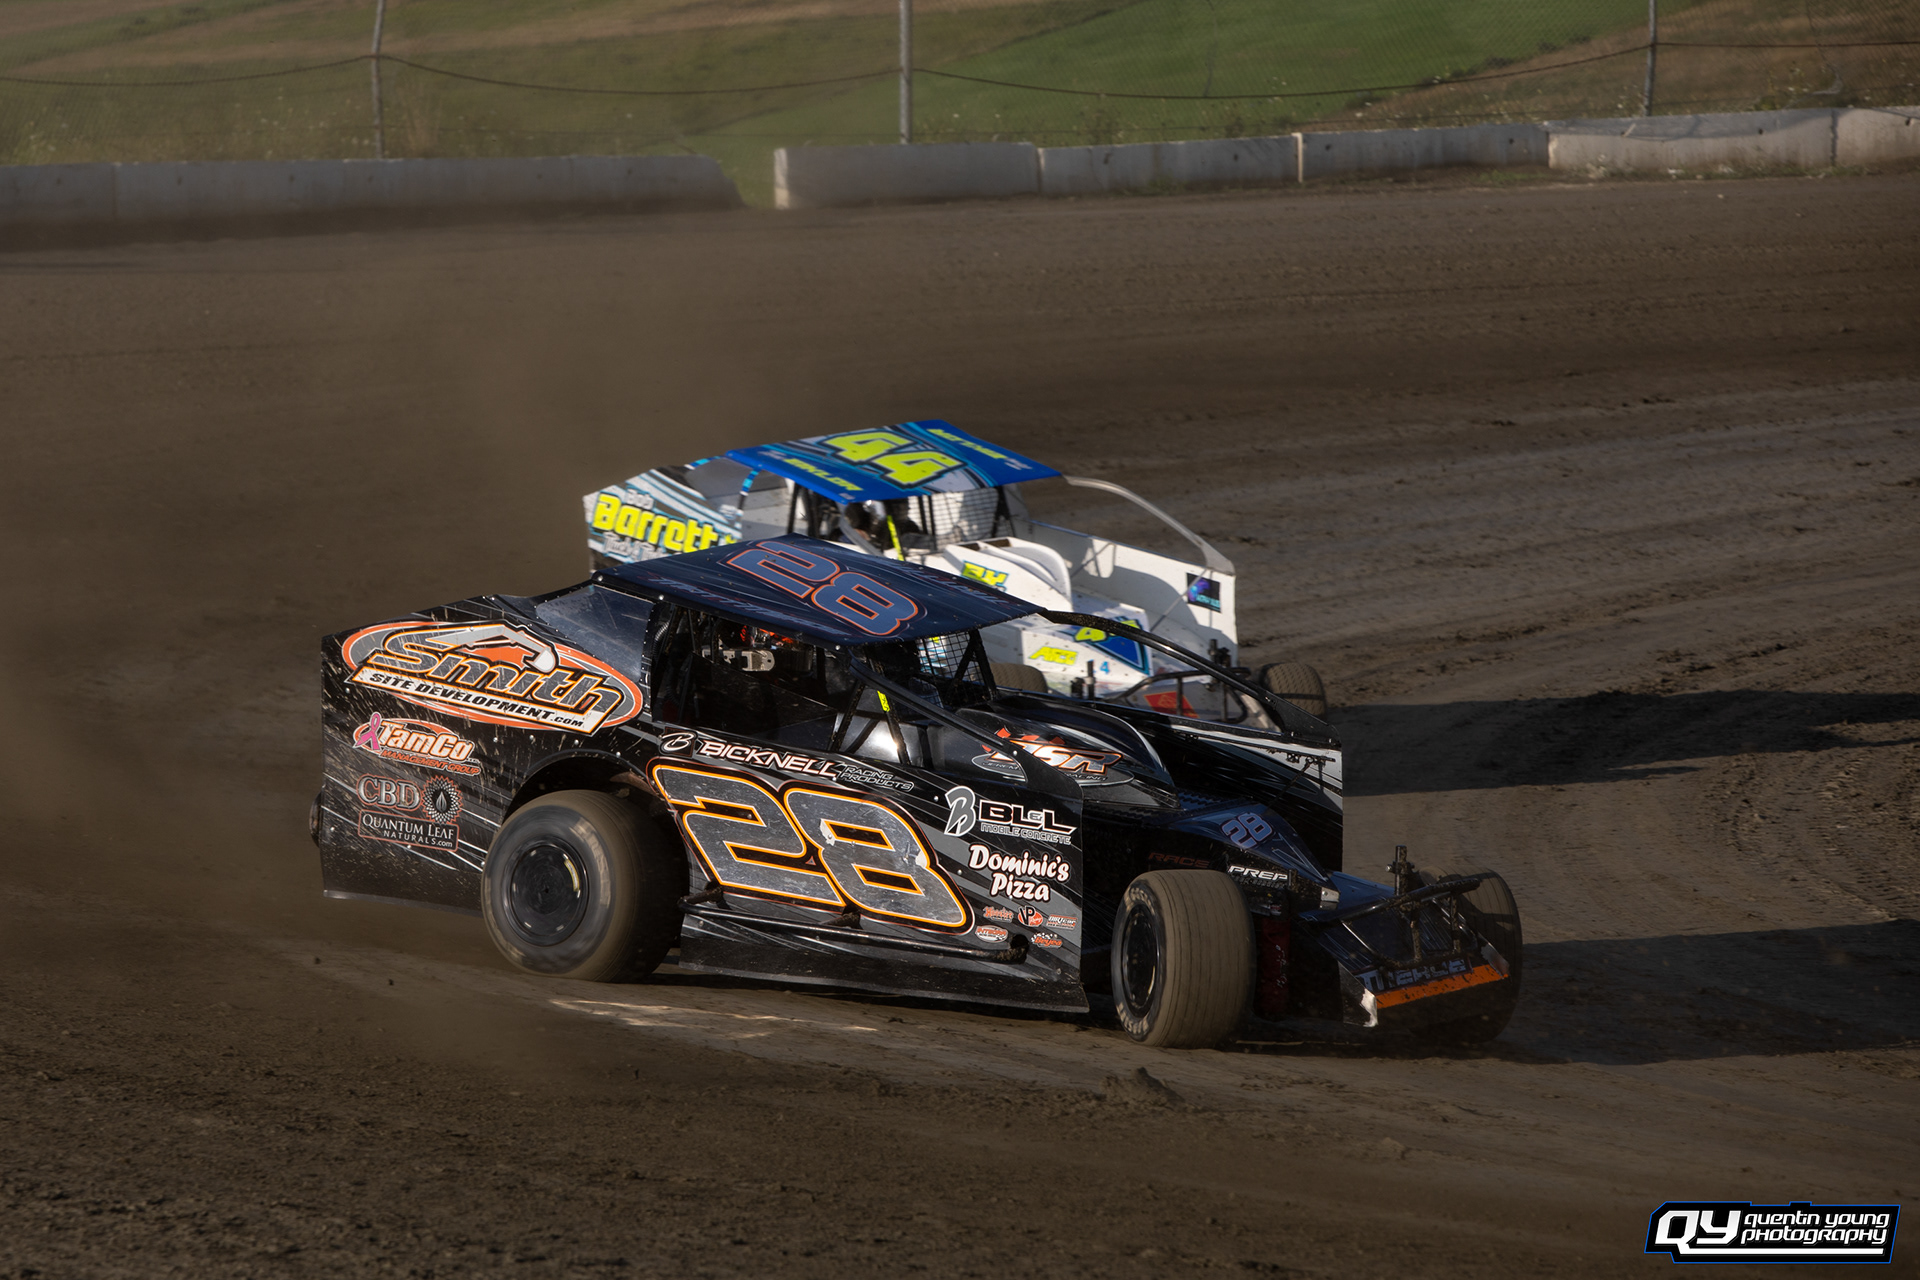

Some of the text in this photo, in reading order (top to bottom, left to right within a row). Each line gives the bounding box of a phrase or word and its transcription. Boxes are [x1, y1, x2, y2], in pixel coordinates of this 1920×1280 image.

[823, 431, 966, 487] 44
[592, 494, 719, 553] Barrett
[725, 540, 919, 636] 28
[366, 624, 625, 715] Smith
[370, 672, 413, 690] SITE
[379, 720, 473, 761] TamCo
[381, 750, 480, 775] MANAGEMENT GROUP
[700, 740, 839, 779] BICKNELL
[844, 766, 893, 781] RACING
[359, 777, 421, 809] CBD
[841, 773, 913, 790] PRODUCTS
[652, 764, 967, 928] 28
[981, 822, 1071, 845] MOBILE CONCRETE
[1221, 812, 1273, 849] 28
[969, 844, 1070, 882] Dominic's
[1148, 852, 1289, 881] RACE PREP
[990, 873, 1050, 901] Pizza
